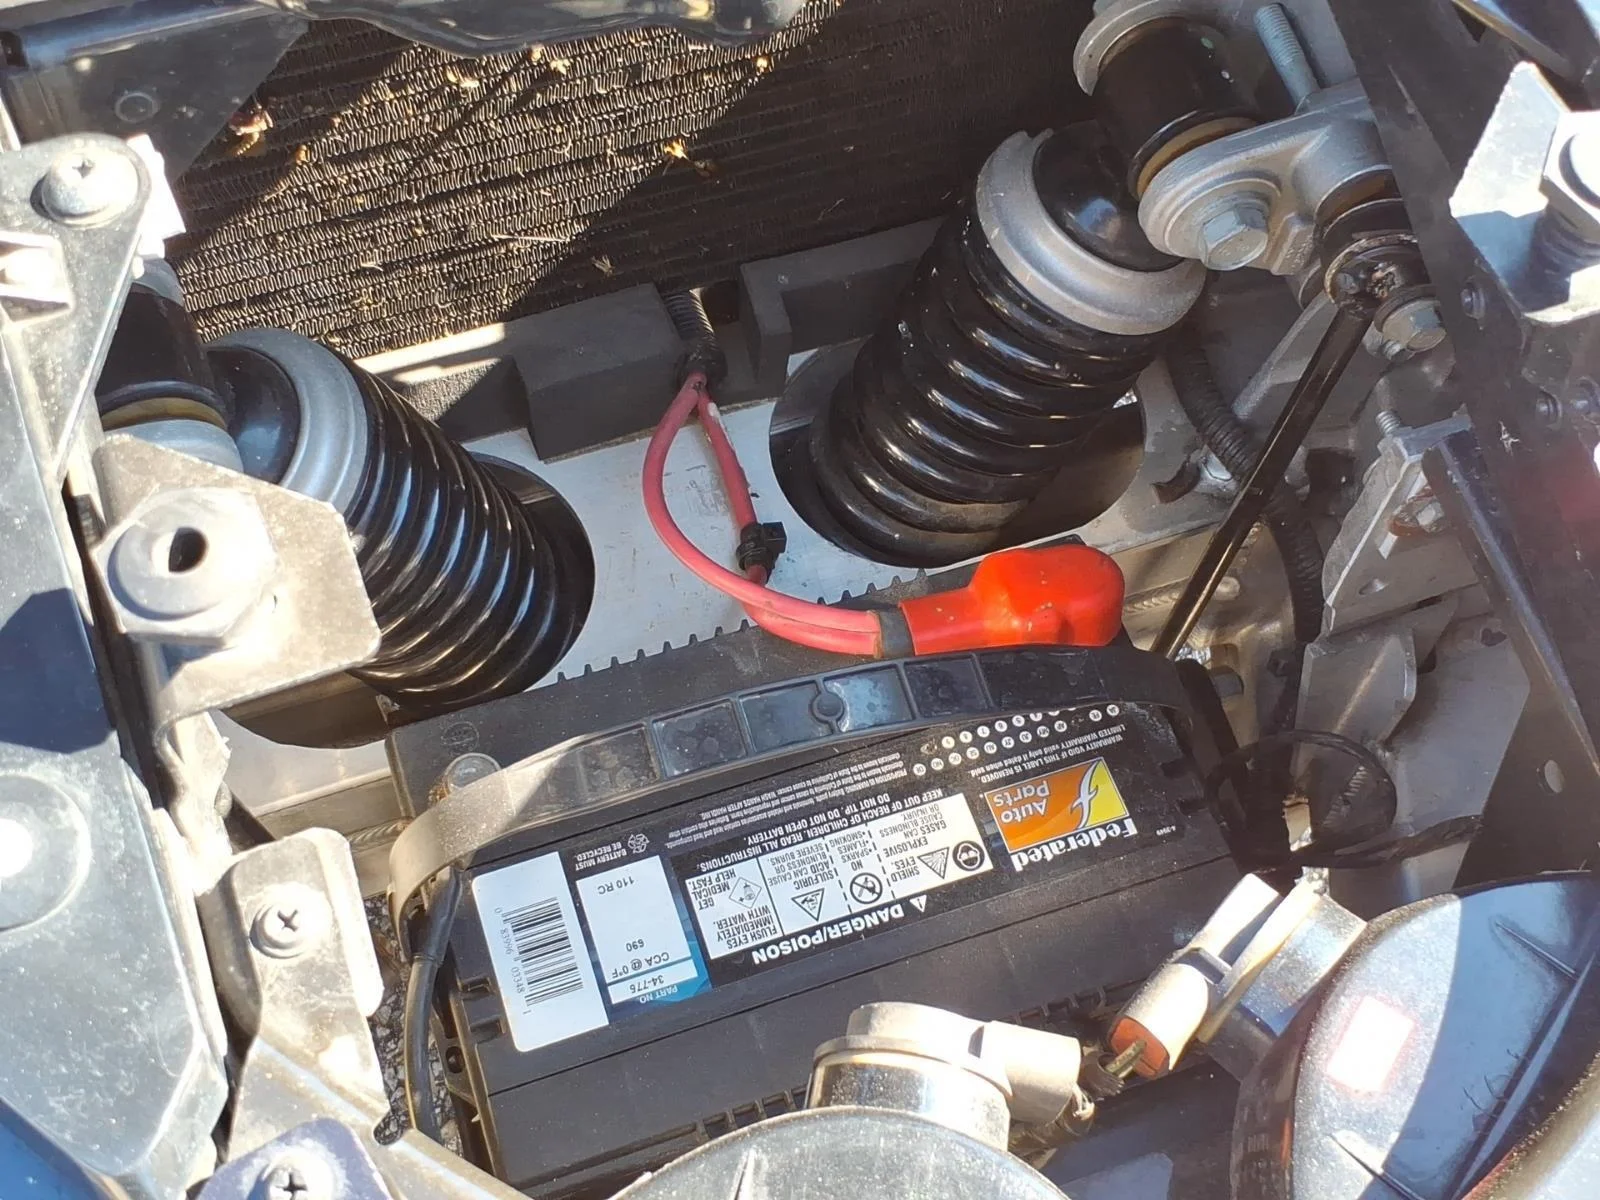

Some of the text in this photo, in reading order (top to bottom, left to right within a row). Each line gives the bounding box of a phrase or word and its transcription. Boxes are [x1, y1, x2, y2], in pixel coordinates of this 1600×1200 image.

[1061, 732, 1097, 749] WARRANTY
[1098, 724, 1125, 737] LIMITED
[1067, 746, 1085, 756] VOID
[1086, 734, 1122, 750] WARRANTY
[1022, 758, 1043, 770] LABEL
[1043, 753, 1059, 763] THIS
[1013, 765, 1022, 773] IS
[992, 781, 1049, 810] Parts
[744, 793, 890, 845] DO NOT TIP. DO NOT OPEN BATTERY.
[901, 803, 939, 821] OR INJURY.
[1001, 799, 1046, 823] Auto
[697, 788, 943, 871] KEEP OUT OF REACH OF CHILDREN. READ ALL INSTRUCTIONS.
[879, 811, 942, 837] CAUSE BLINDNESS
[903, 819, 946, 839] GASES CAN
[575, 841, 622, 861] BE RECYCLED.
[767, 842, 823, 866] SEVERE BURNS.
[883, 836, 928, 857] EXPLOSIVE
[1011, 819, 1136, 871] Federated
[575, 848, 627, 871] BATTERY MUST
[774, 851, 827, 874] BLINDNESS OR
[850, 859, 863, 871] NO
[891, 856, 915, 870] EYES.
[688, 868, 736, 890] HELP FAST.
[767, 860, 829, 886] ACID CAN CAUSE
[793, 870, 834, 890] SULFURIC
[890, 865, 920, 882] SHIELD
[597, 876, 634, 895] 110 RC
[691, 881, 730, 900] MEDICAL
[698, 897, 714, 910] GET
[713, 905, 770, 929] WITH WATER.
[717, 915, 773, 941] IMMEDIATELY
[726, 924, 777, 949] FLUSH EYES
[753, 905, 903, 962] DANGER/POISON
[625, 938, 644, 952] 690
[630, 958, 642, 971] @
[644, 951, 669, 966] CCA
[655, 985, 678, 998] PART
